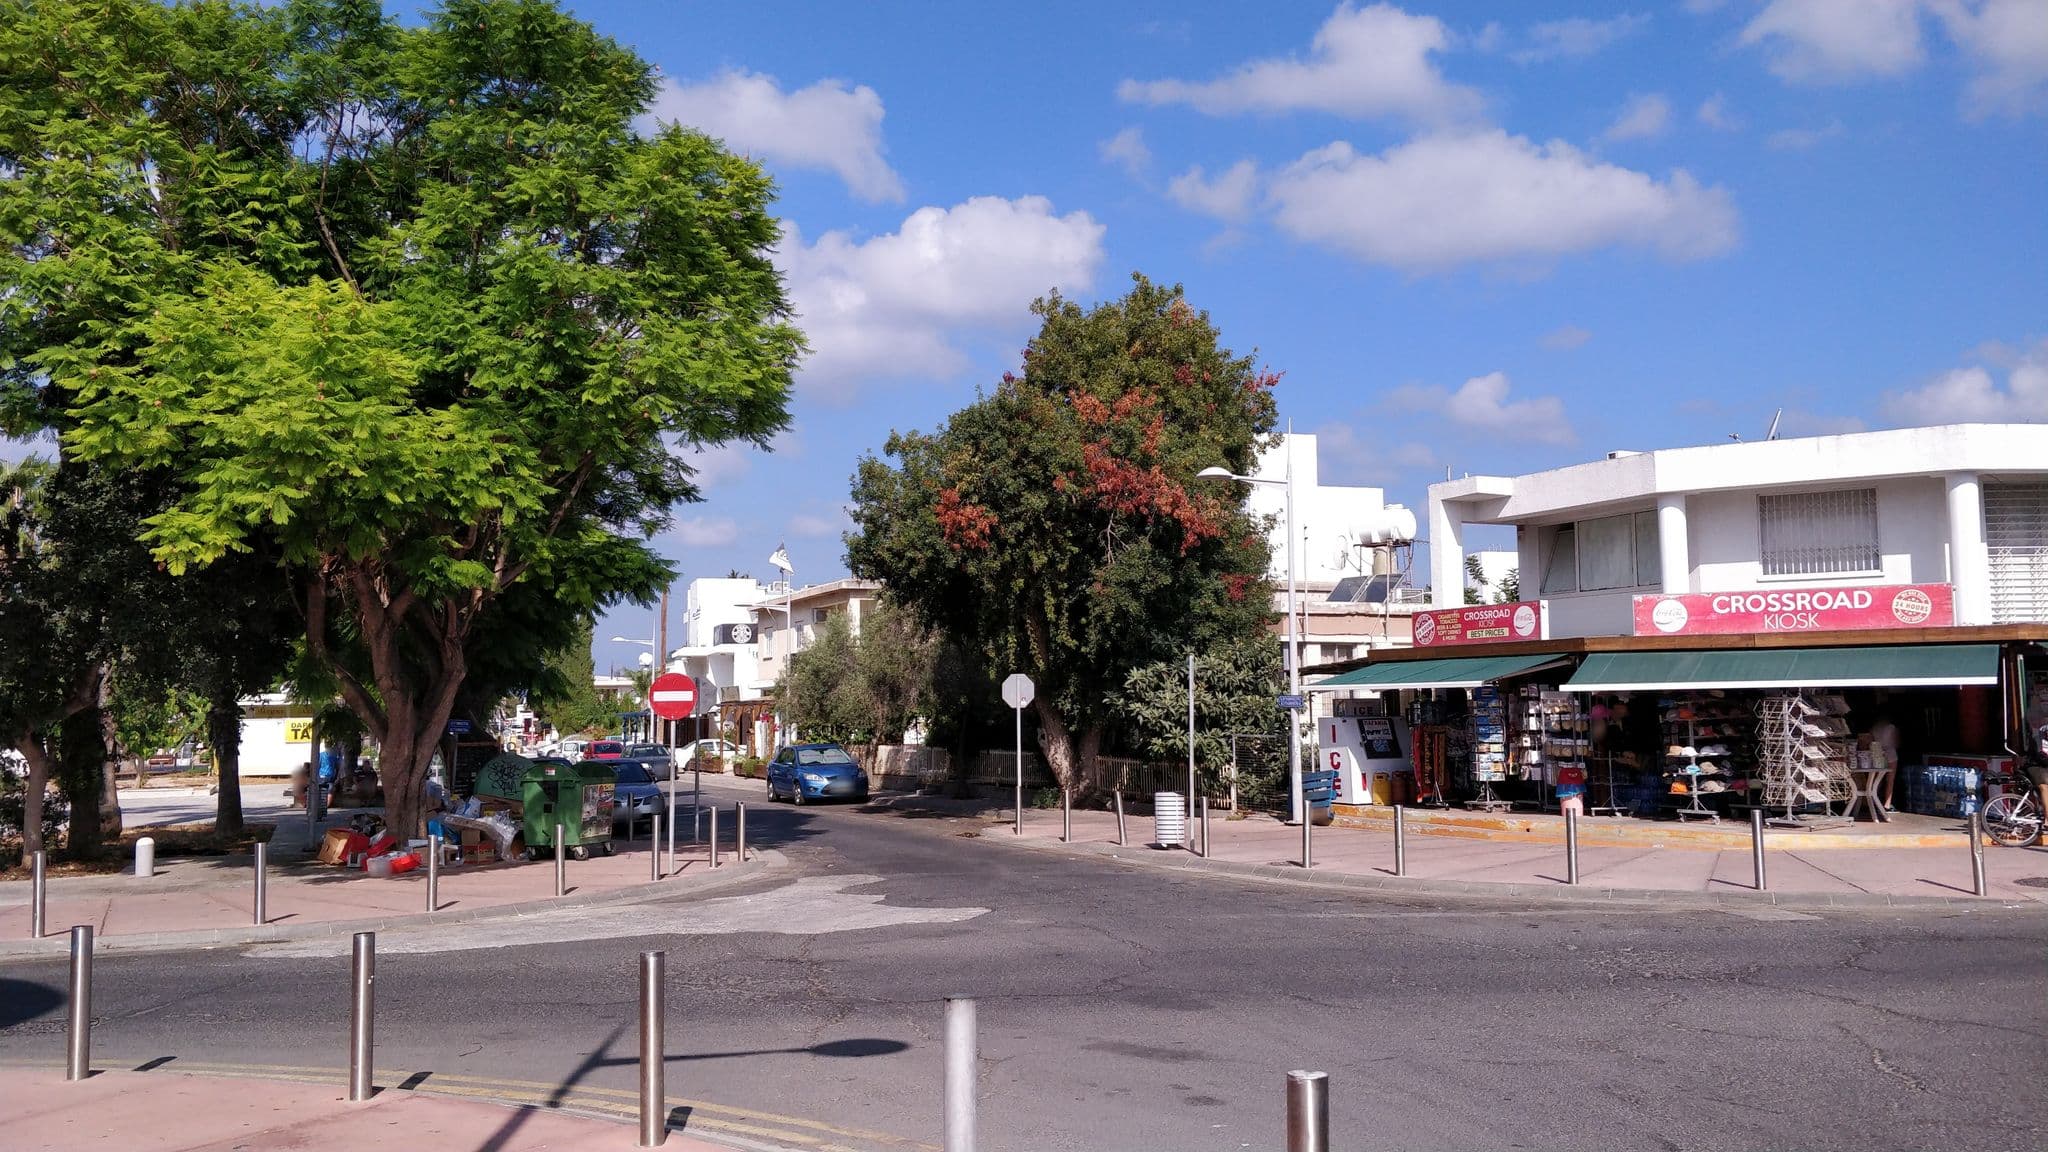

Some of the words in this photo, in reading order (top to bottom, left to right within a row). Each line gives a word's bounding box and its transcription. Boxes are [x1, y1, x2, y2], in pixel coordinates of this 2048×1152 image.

[1713, 590, 1873, 614] CROSSROAD
[1905, 603, 1928, 613] HOURS
[1464, 609, 1511, 621] CROSSROAD
[1478, 620, 1495, 628] KIOSK
[1764, 612, 1820, 630] KIOSK
[1470, 629, 1484, 638] BEST
[1484, 628, 1506, 637] PRICES
[1353, 706, 1373, 715] ICE
[1330, 725, 1342, 797] ICE
